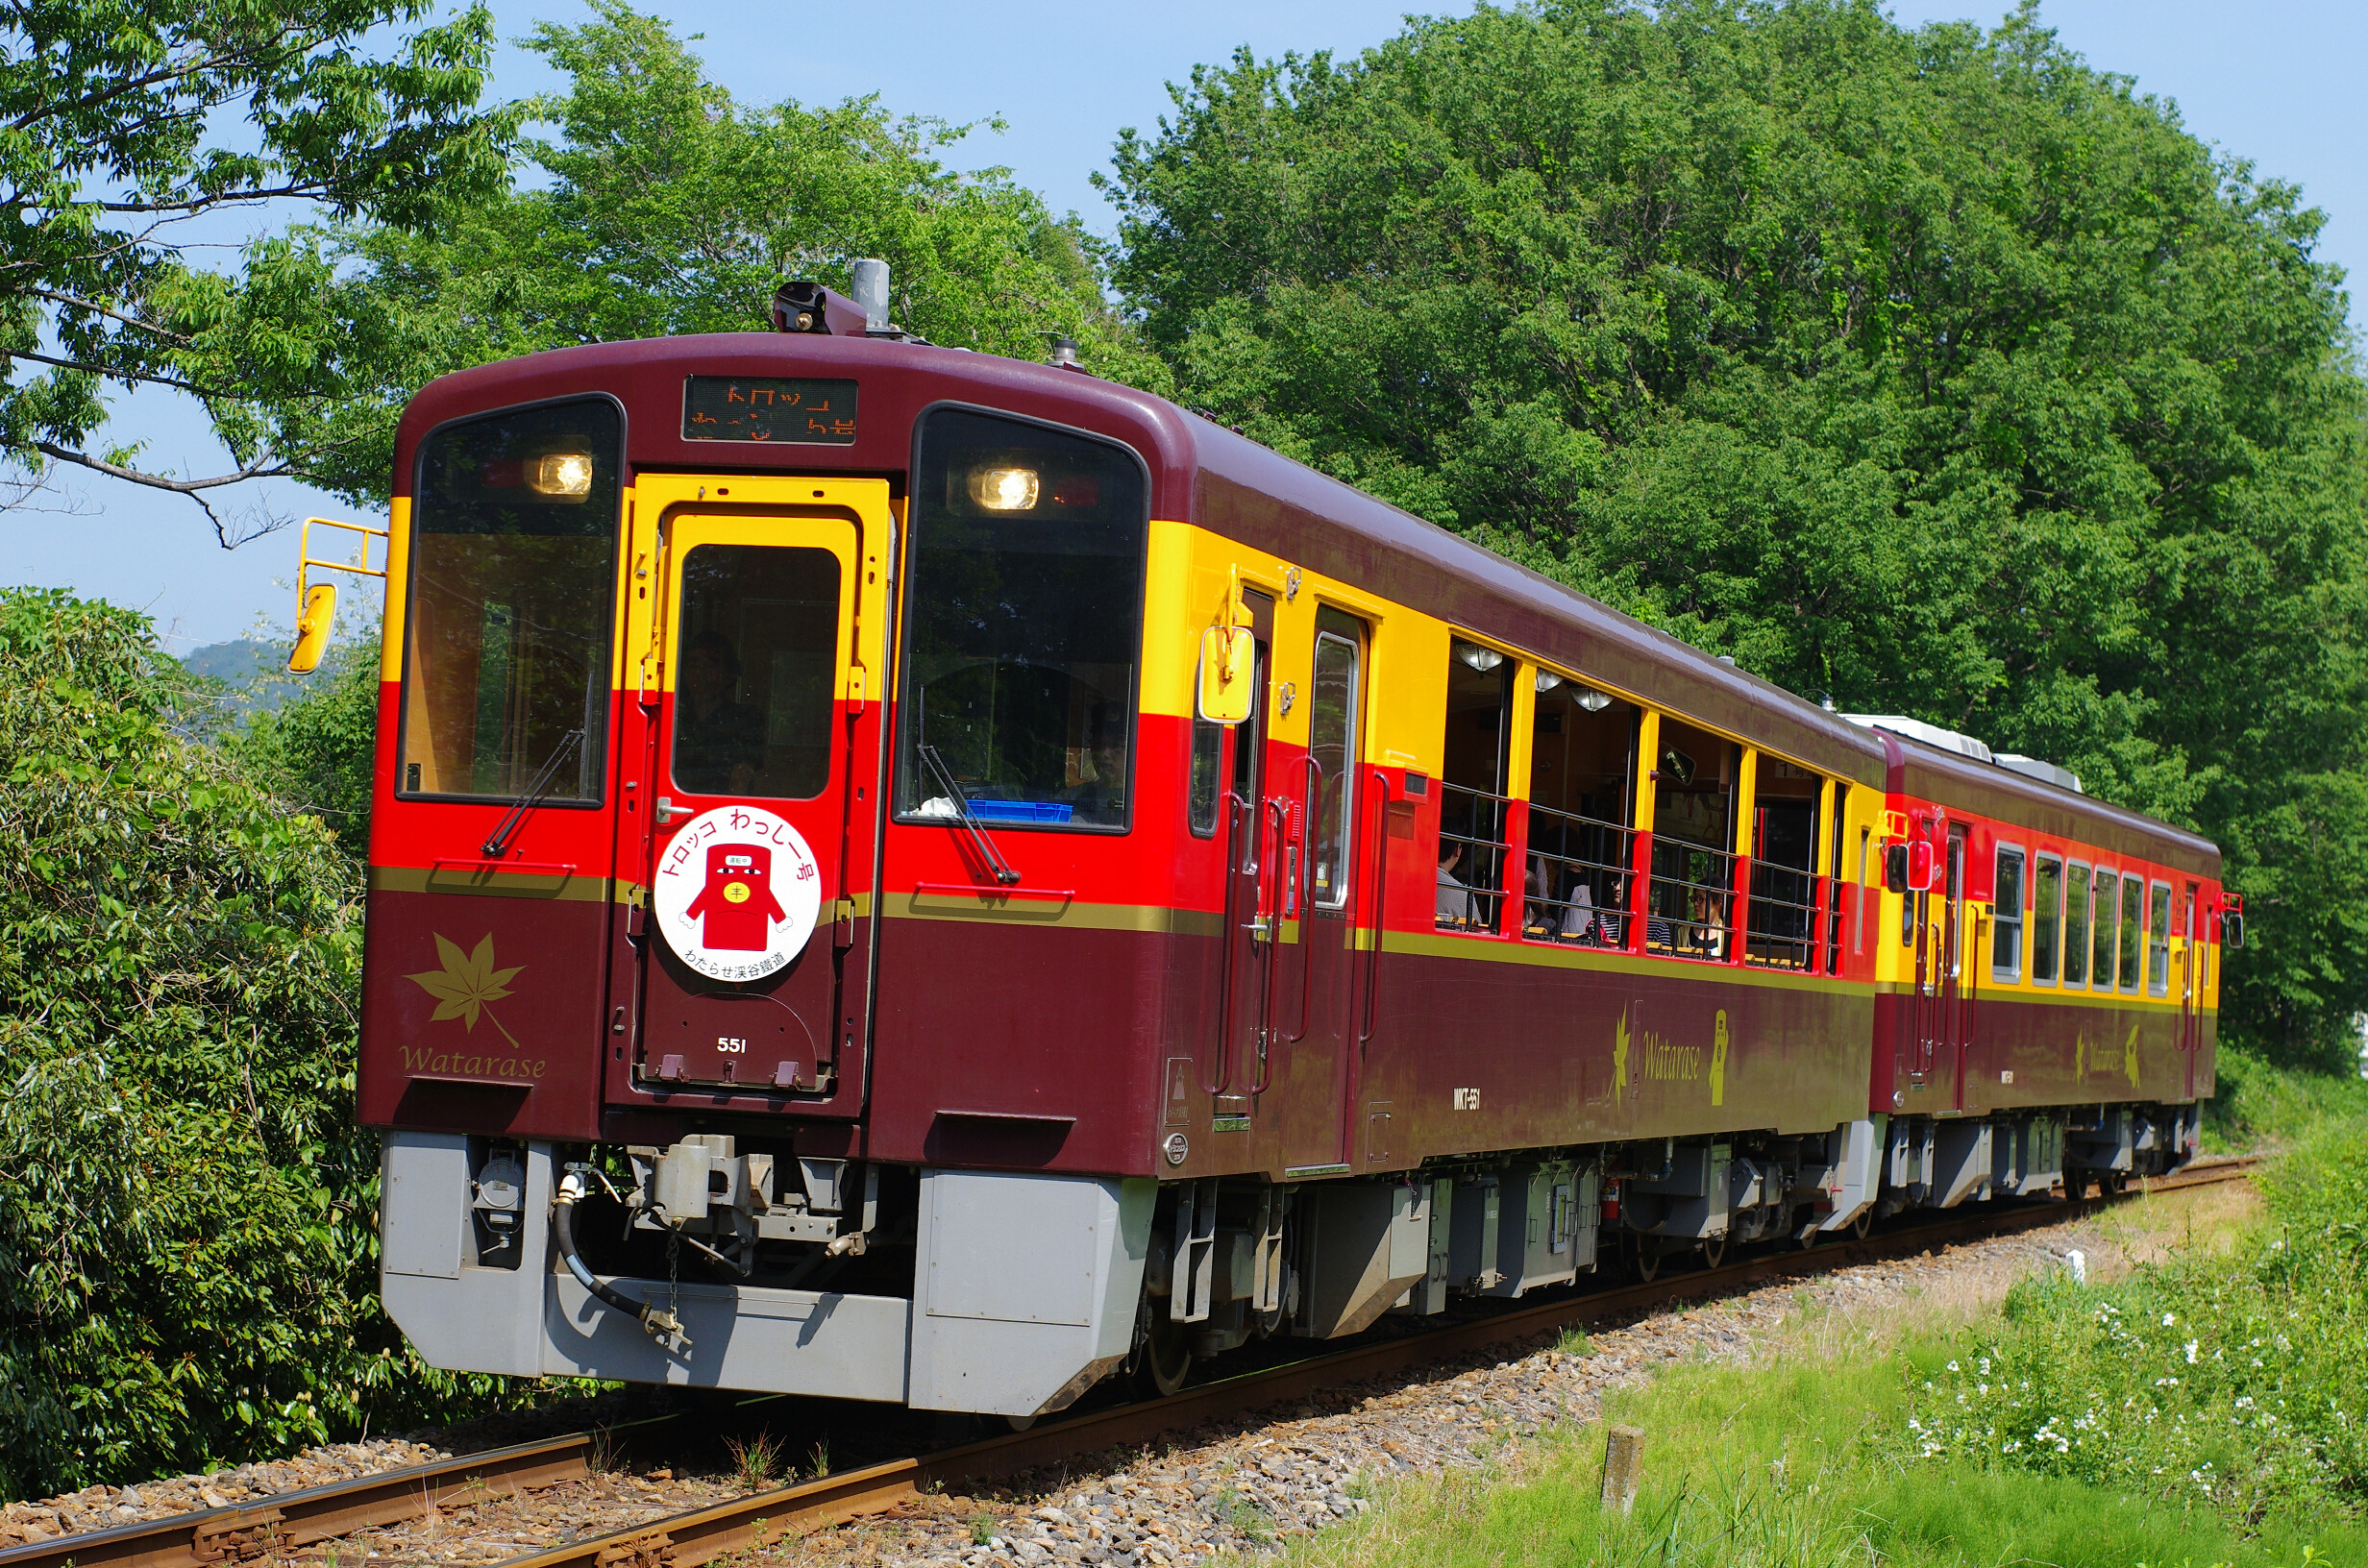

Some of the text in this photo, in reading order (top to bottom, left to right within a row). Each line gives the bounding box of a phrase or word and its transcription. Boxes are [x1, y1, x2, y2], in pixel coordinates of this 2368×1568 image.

[662, 808, 815, 882] トロッコ わっしー号
[684, 949, 786, 979] わたらせ渓谷鐵道
[398, 1044, 546, 1079] Watarase
[717, 1037, 747, 1054] 551
[1643, 1030, 1700, 1081] Watarase
[1453, 1087, 1481, 1111] WKT-551
